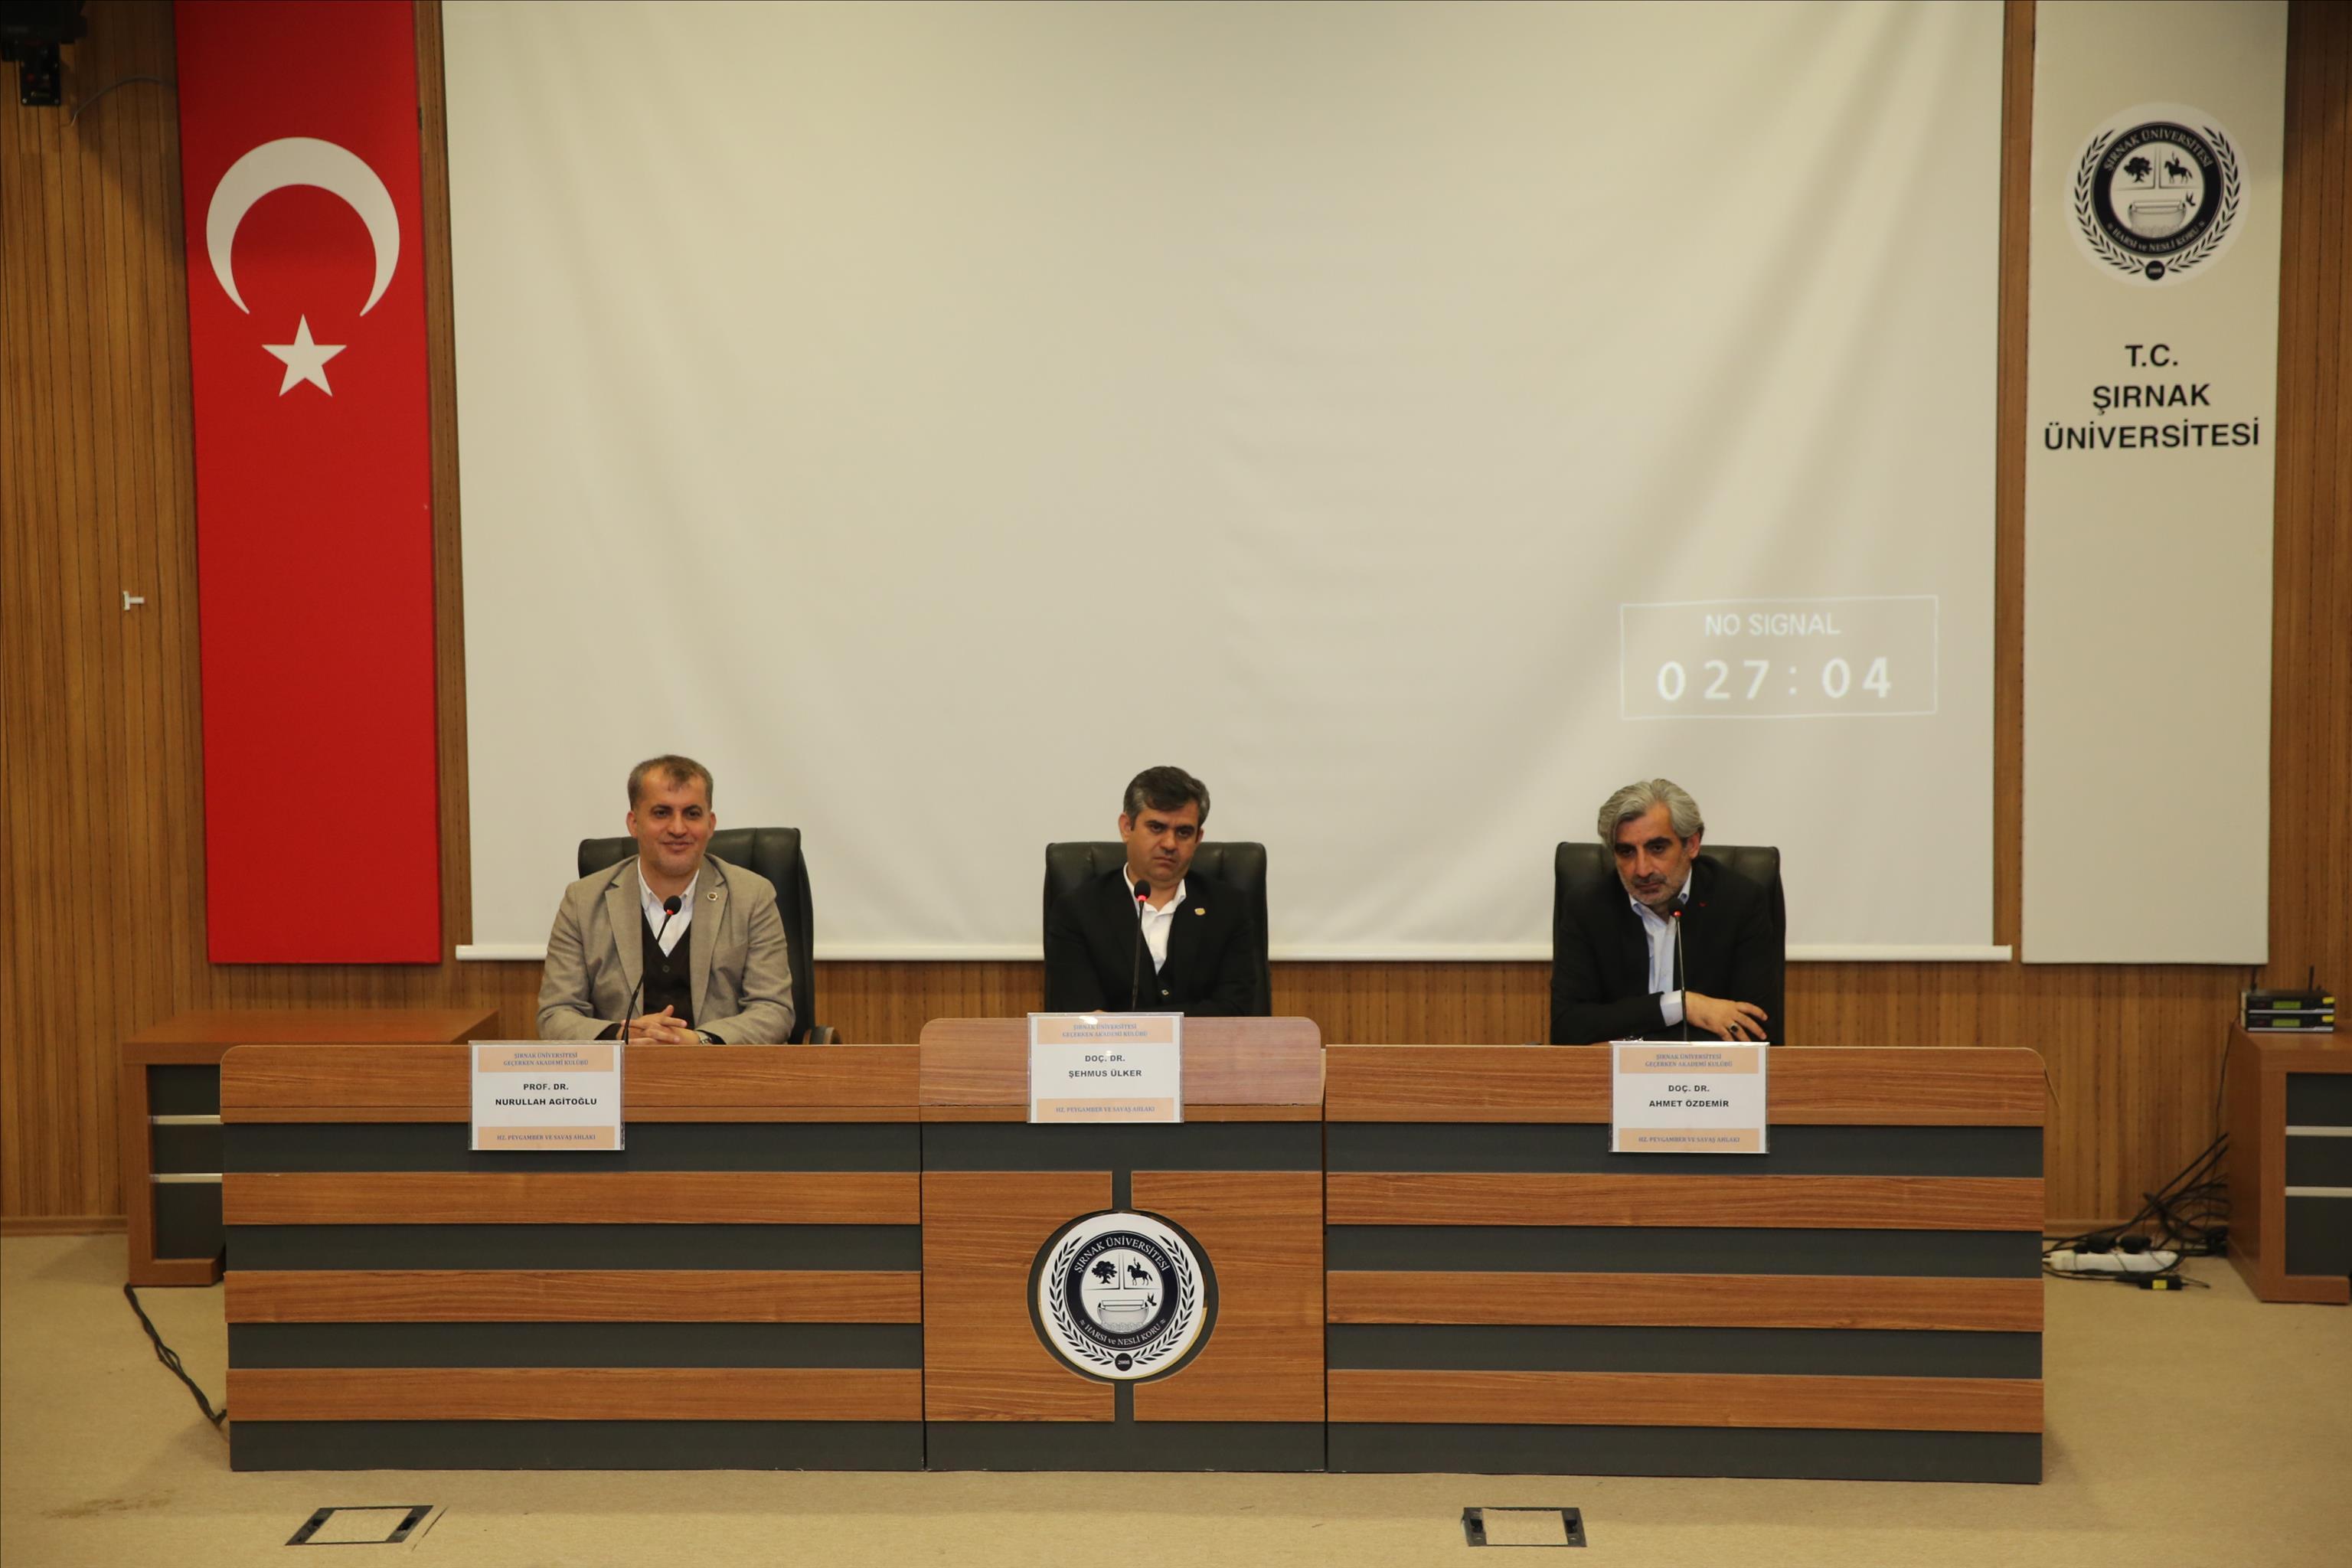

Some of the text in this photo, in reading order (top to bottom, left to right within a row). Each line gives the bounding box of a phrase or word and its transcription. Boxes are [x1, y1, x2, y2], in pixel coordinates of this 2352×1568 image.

[2124, 344, 2178, 368] T.C.
[2092, 384, 2211, 415] ŞIRNAK
[2044, 417, 2259, 450] ÜNİVERSİTESİ
[1704, 612, 1842, 636] NO SIGNAL
[1068, 1068, 1142, 1078] ŞEHMUS ÜLKER
[1073, 1235, 1171, 1274] ŞIRNAK ÜNİVERSİTESİ
[1118, 1336, 1140, 1346] NESLİ
[1141, 1324, 1161, 1341] KORU
